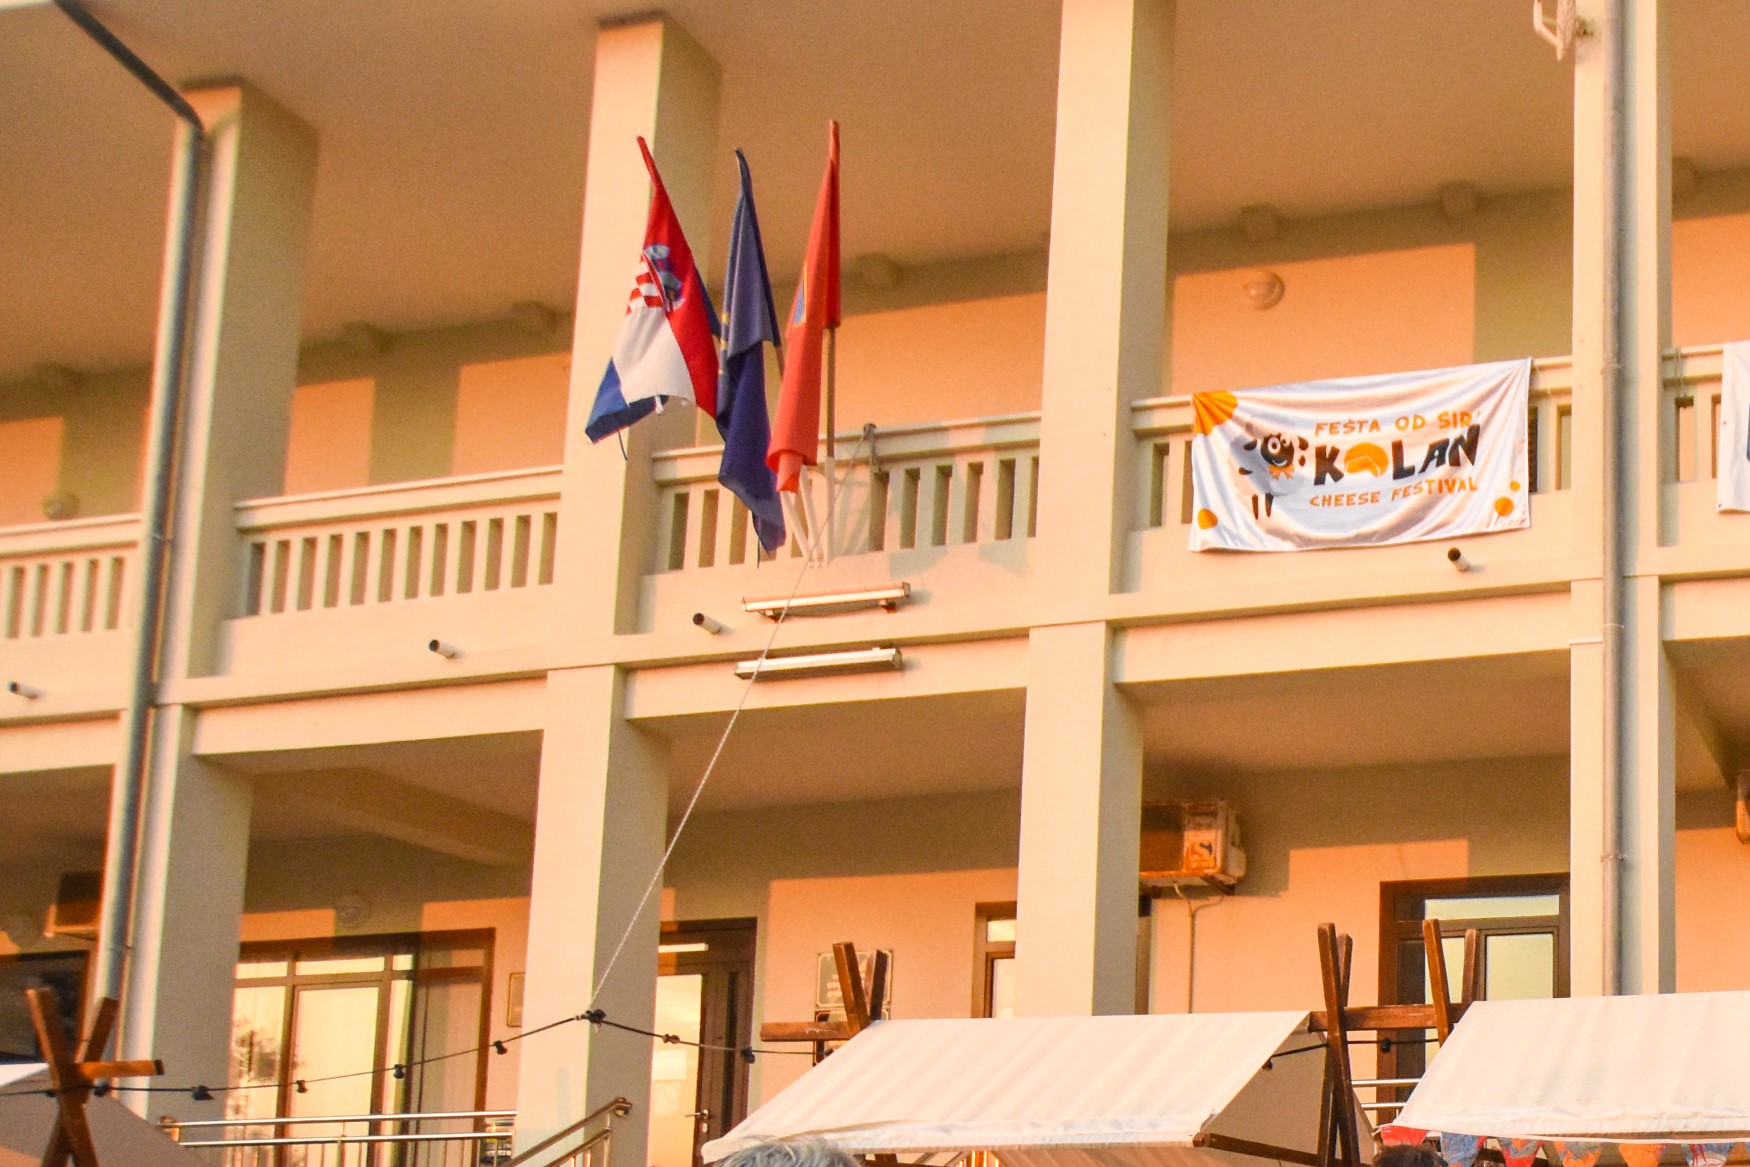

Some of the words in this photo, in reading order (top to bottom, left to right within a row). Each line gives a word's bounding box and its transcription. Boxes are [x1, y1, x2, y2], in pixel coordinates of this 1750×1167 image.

[1314, 417, 1381, 437] FEŠTA
[1394, 414, 1426, 431] OD
[1313, 424, 1481, 486] KOLAN
[1308, 490, 1381, 508] CHEESE
[1391, 476, 1479, 501] FESTIVAL
